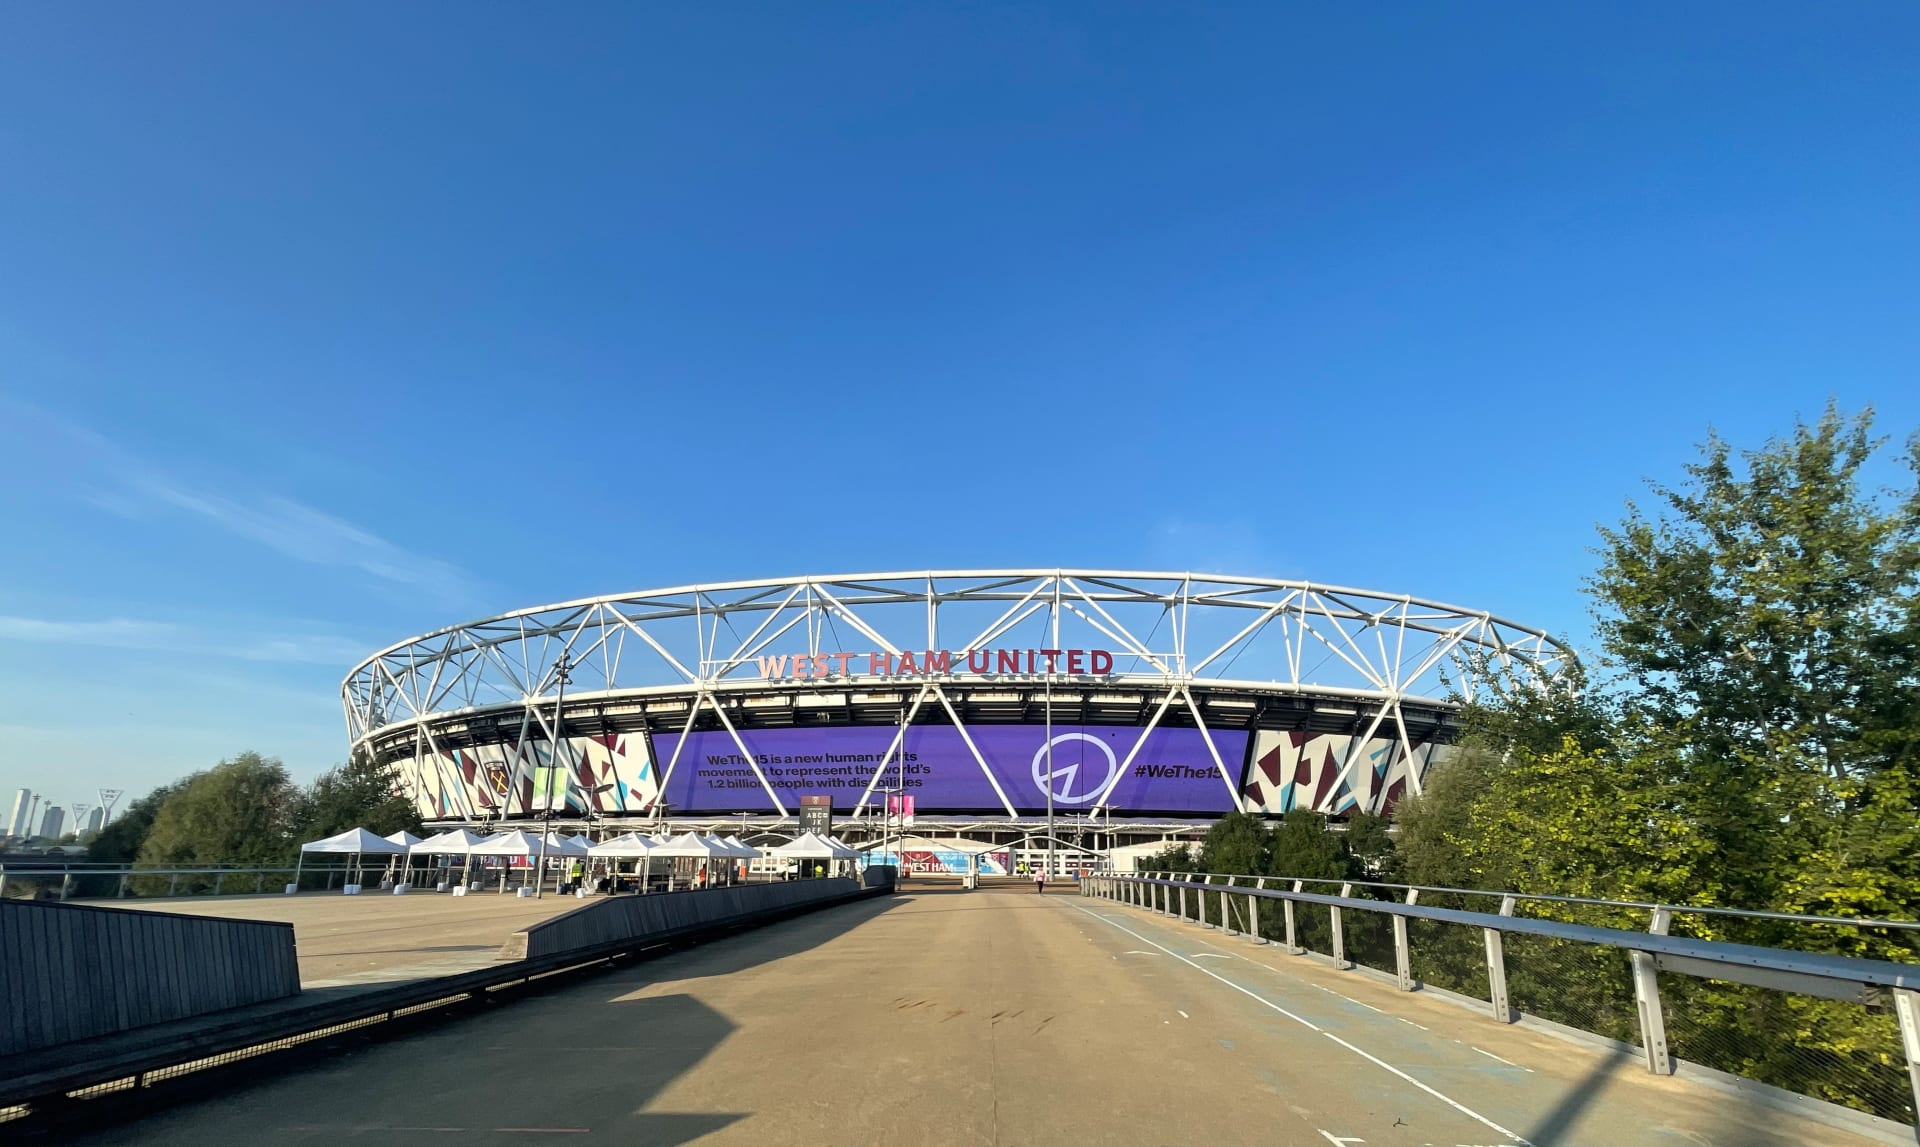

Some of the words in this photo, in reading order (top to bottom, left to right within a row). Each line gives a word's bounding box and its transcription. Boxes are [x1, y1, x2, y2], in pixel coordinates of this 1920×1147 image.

[758, 652, 855, 680] WEST
[869, 649, 951, 677] HAM
[968, 649, 1114, 675] UNITED
[706, 754, 769, 765] WeTh15
[771, 753, 782, 764] is
[784, 756, 793, 764] a
[794, 755, 823, 764] new
[825, 752, 874, 763] human
[769, 767, 784, 776] to
[785, 765, 853, 778] represent
[855, 764, 877, 775] the
[1134, 764, 1224, 780] #WeThe15
[707, 779, 726, 789] 1.2
[816, 777, 846, 788] with
[848, 777, 924, 788] disbilities
